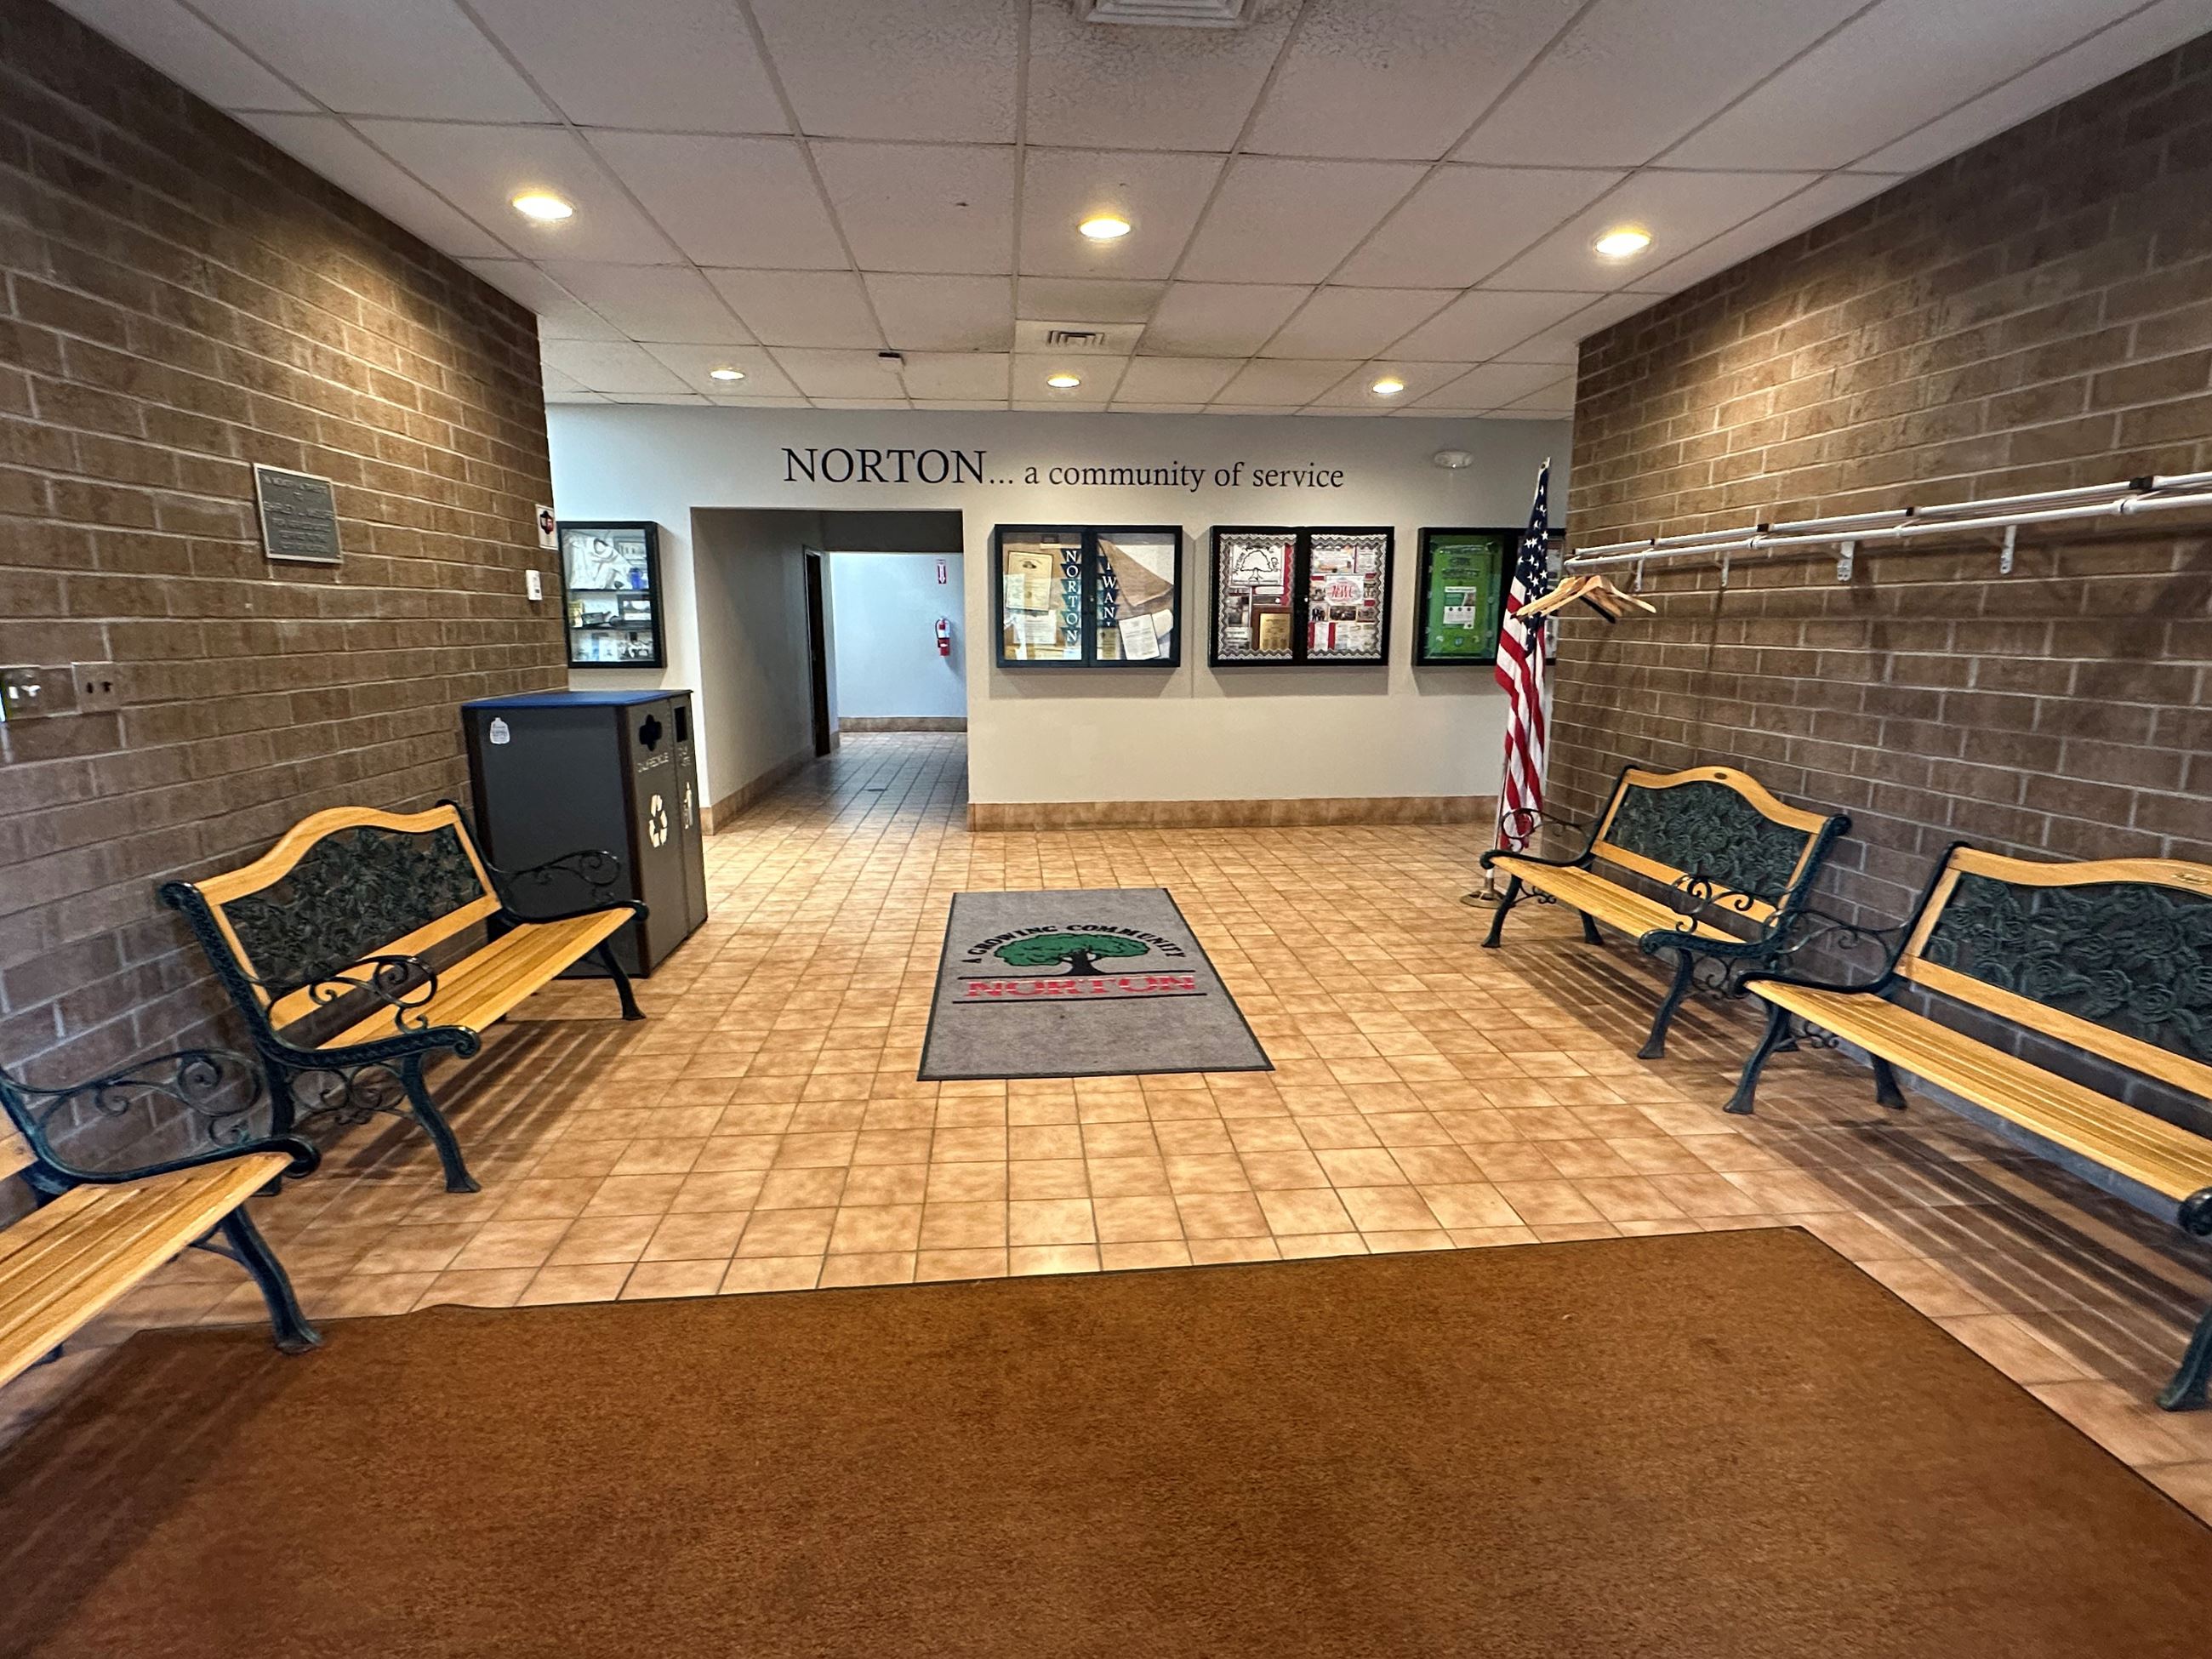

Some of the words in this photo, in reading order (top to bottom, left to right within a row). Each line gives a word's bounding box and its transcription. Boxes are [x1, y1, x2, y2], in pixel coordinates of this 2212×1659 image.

[1024, 465, 1040, 485] a
[1048, 460, 1206, 493] community
[1214, 461, 1245, 487] of
[1252, 462, 1345, 487] service
[1065, 550, 1080, 641] NORTON
[967, 926, 1058, 955] GROWING
[1066, 924, 1187, 958] COMMUNITY
[963, 975, 1197, 998] NORTON
